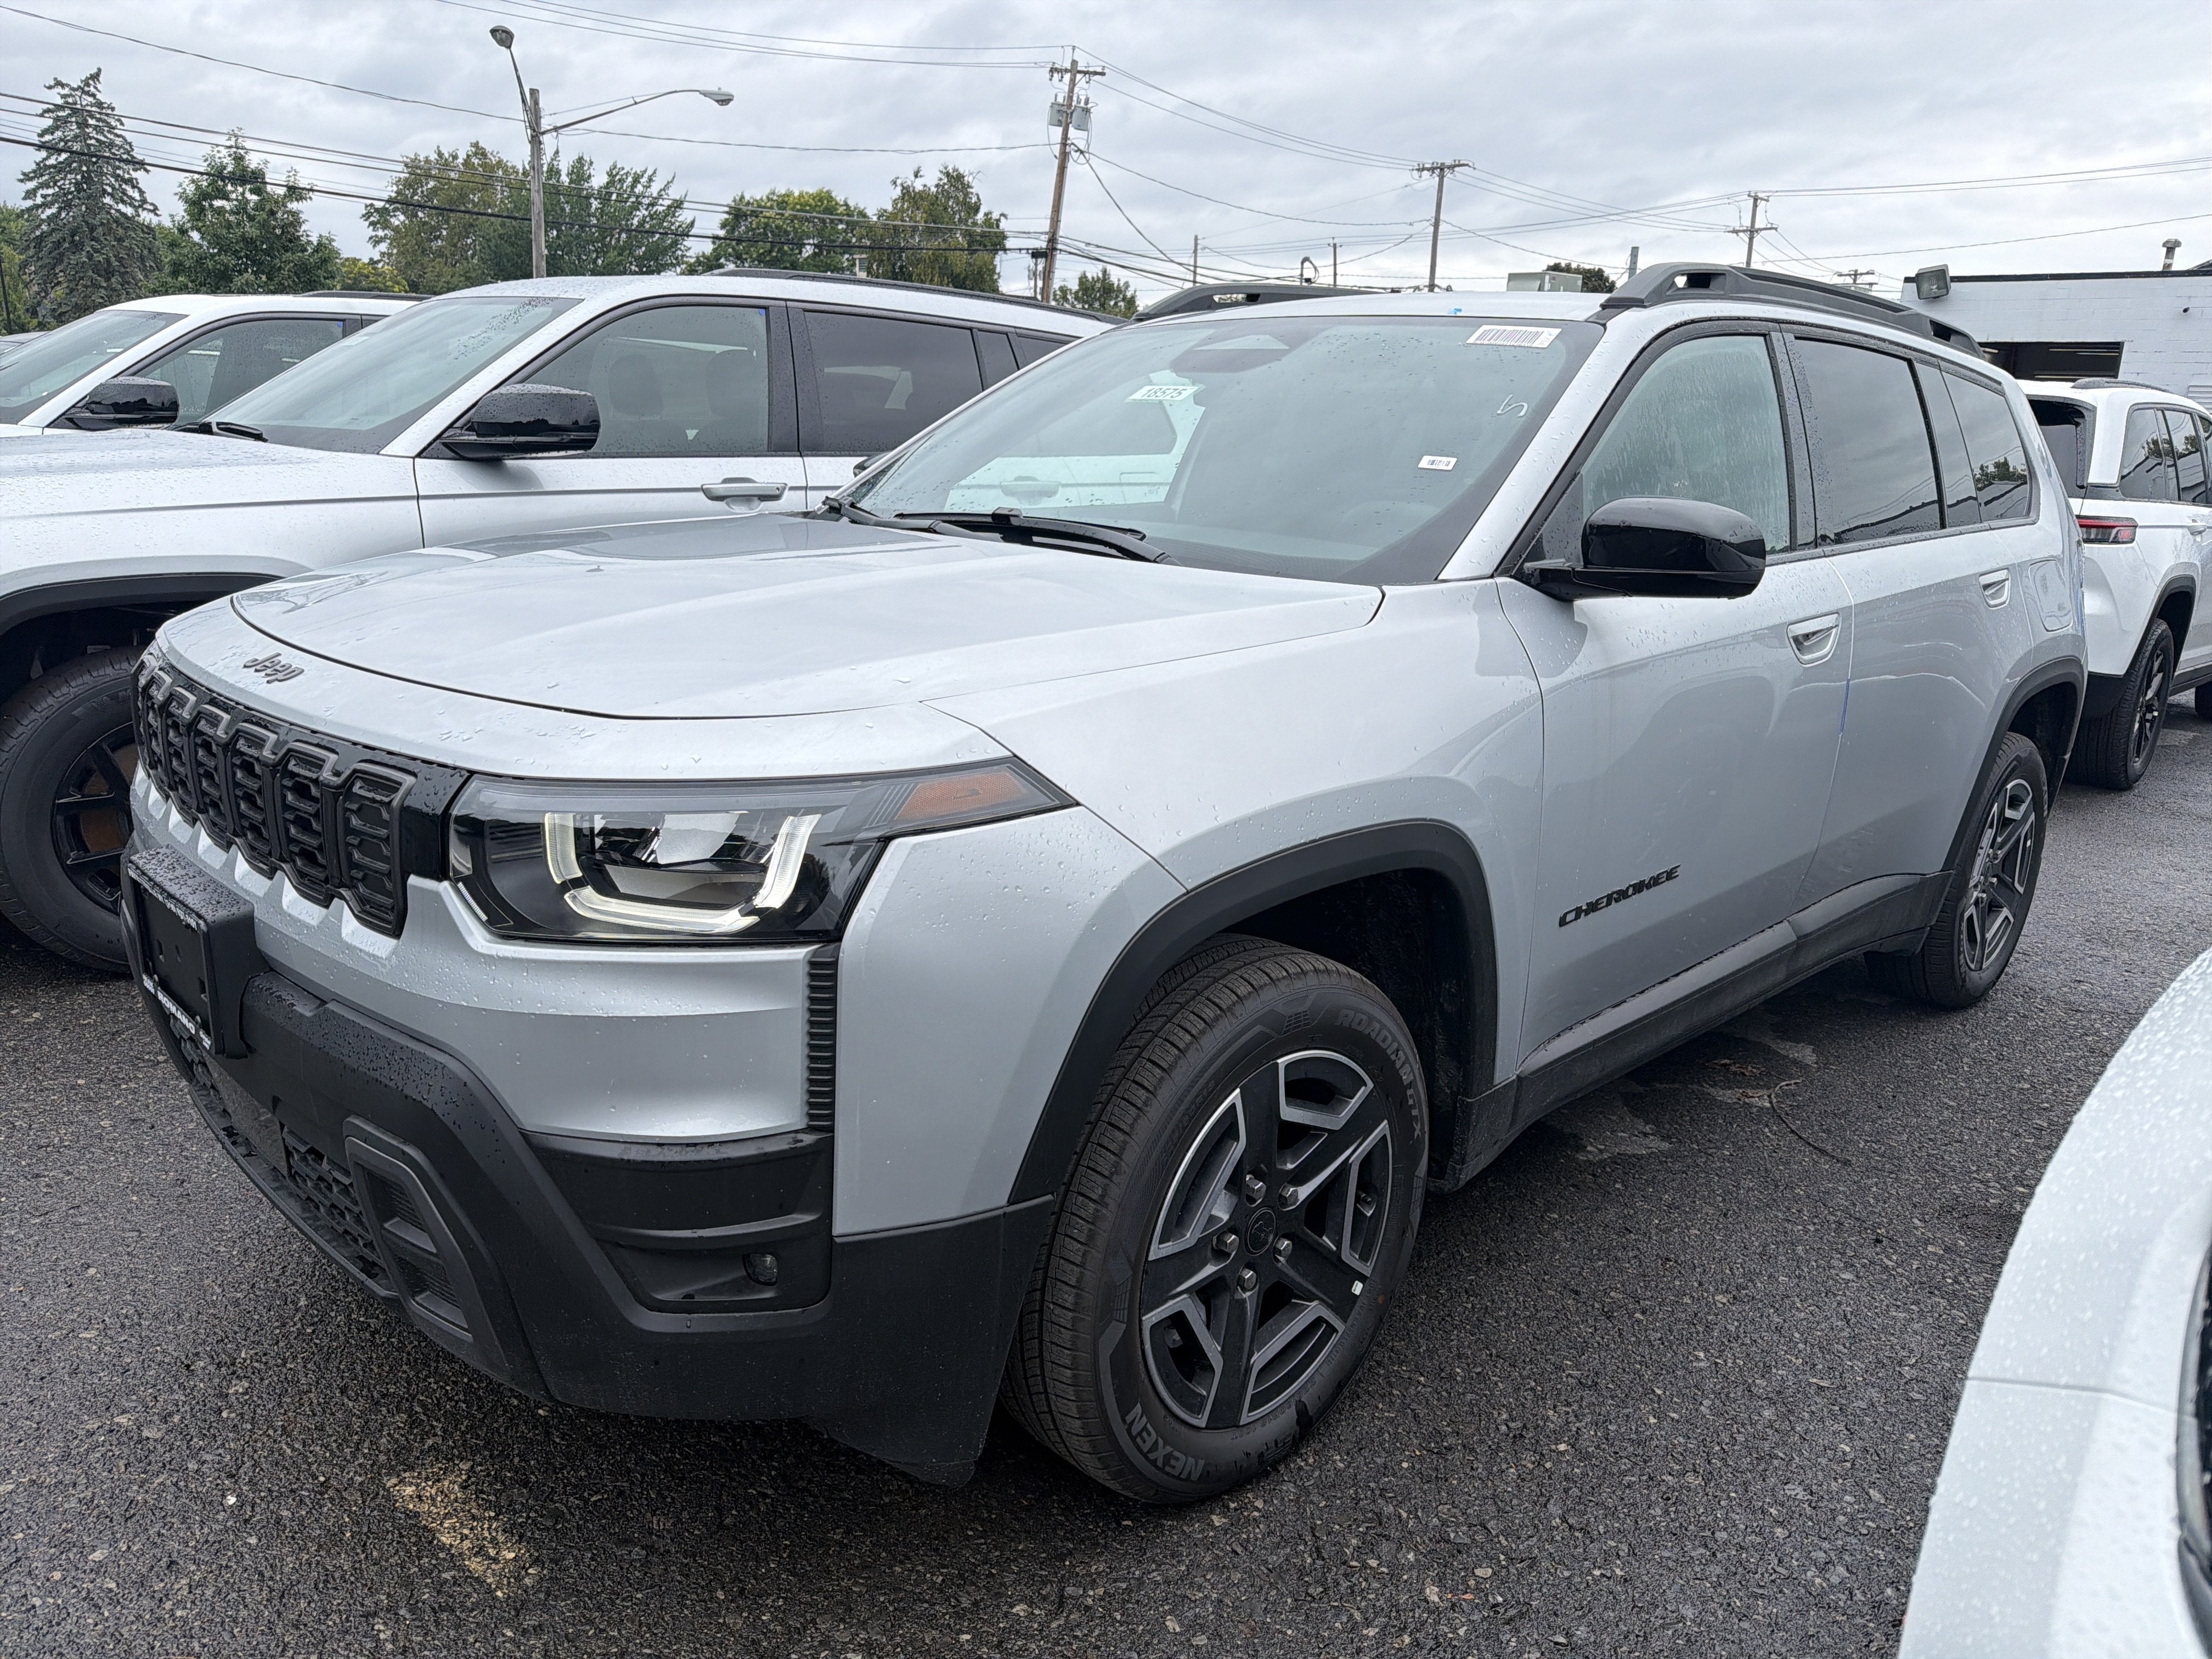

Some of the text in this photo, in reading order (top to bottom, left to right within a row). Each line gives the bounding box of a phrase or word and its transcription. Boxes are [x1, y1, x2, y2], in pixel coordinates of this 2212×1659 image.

[1141, 387, 1187, 398] 18575
[243, 652, 305, 684] Jeep
[1559, 864, 1681, 928] CHEROKEE
[157, 990, 196, 1035] ROMANO
[1335, 1008, 1414, 1086] ROADIAN
[1125, 1401, 1205, 1481] NEXEN
